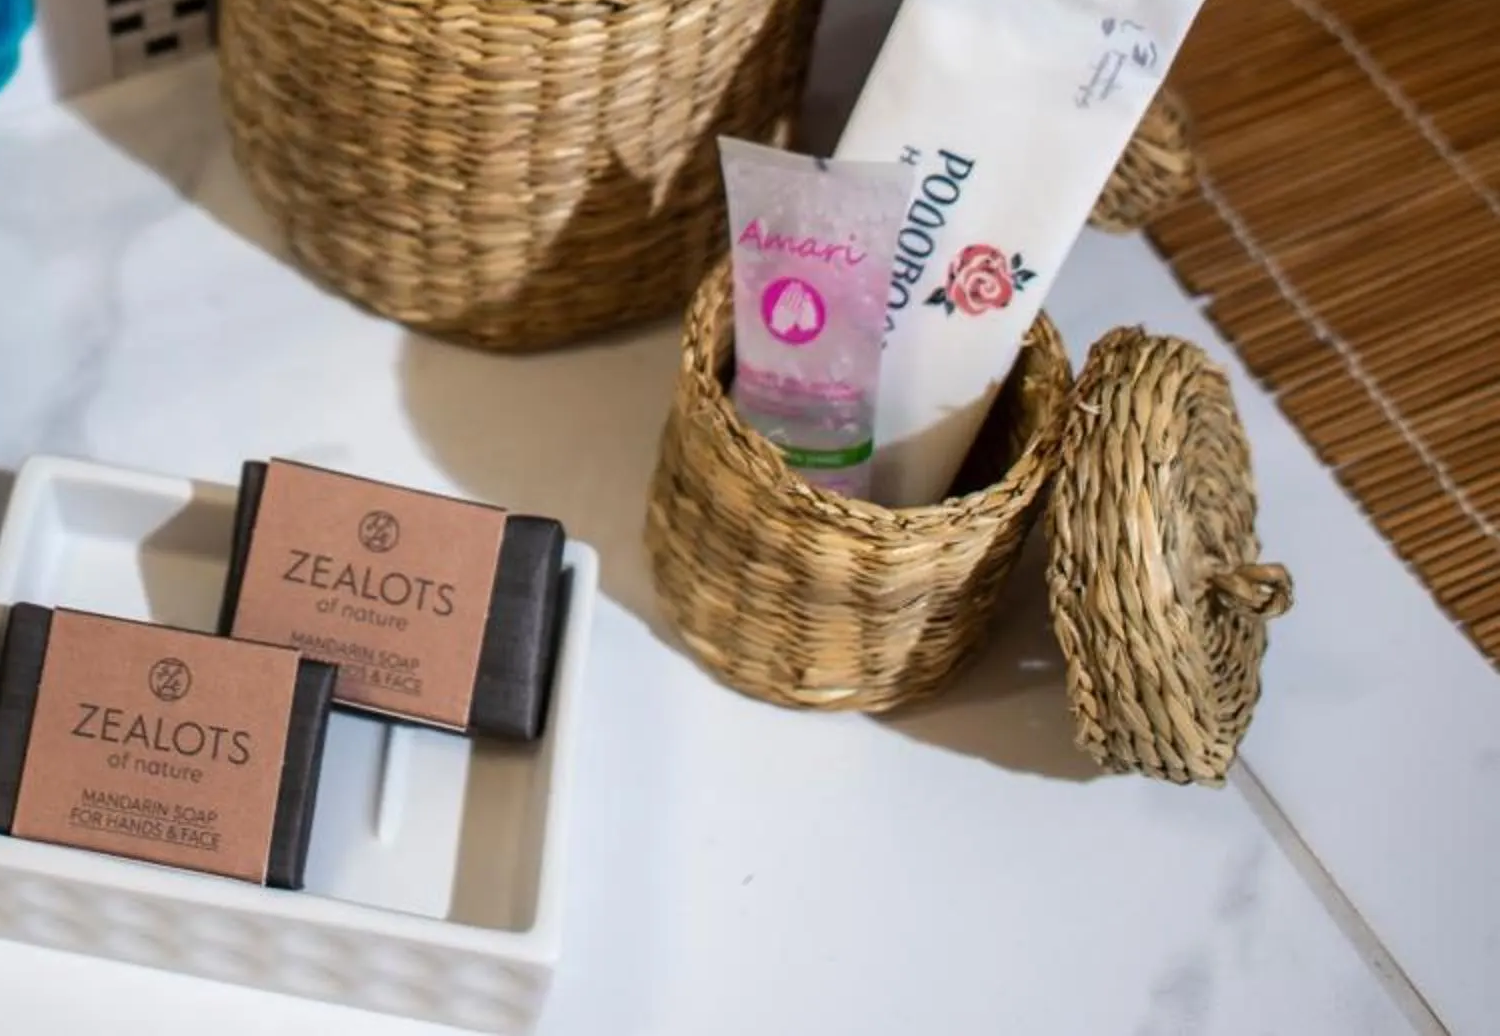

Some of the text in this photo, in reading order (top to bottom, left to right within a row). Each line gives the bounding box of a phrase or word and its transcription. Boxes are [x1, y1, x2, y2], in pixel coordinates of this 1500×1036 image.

[737, 217, 866, 267] Amari
[282, 549, 456, 616] ZEALOTS
[314, 597, 410, 632] of nature
[290, 630, 421, 670] MANDARIN SOAP
[384, 673, 423, 695] FACE
[70, 702, 252, 766] ZEALOTS
[106, 751, 205, 784] of nature
[81, 788, 219, 824] MANDARIN SOAP
[71, 806, 224, 851] FOR HANDS & FACE
